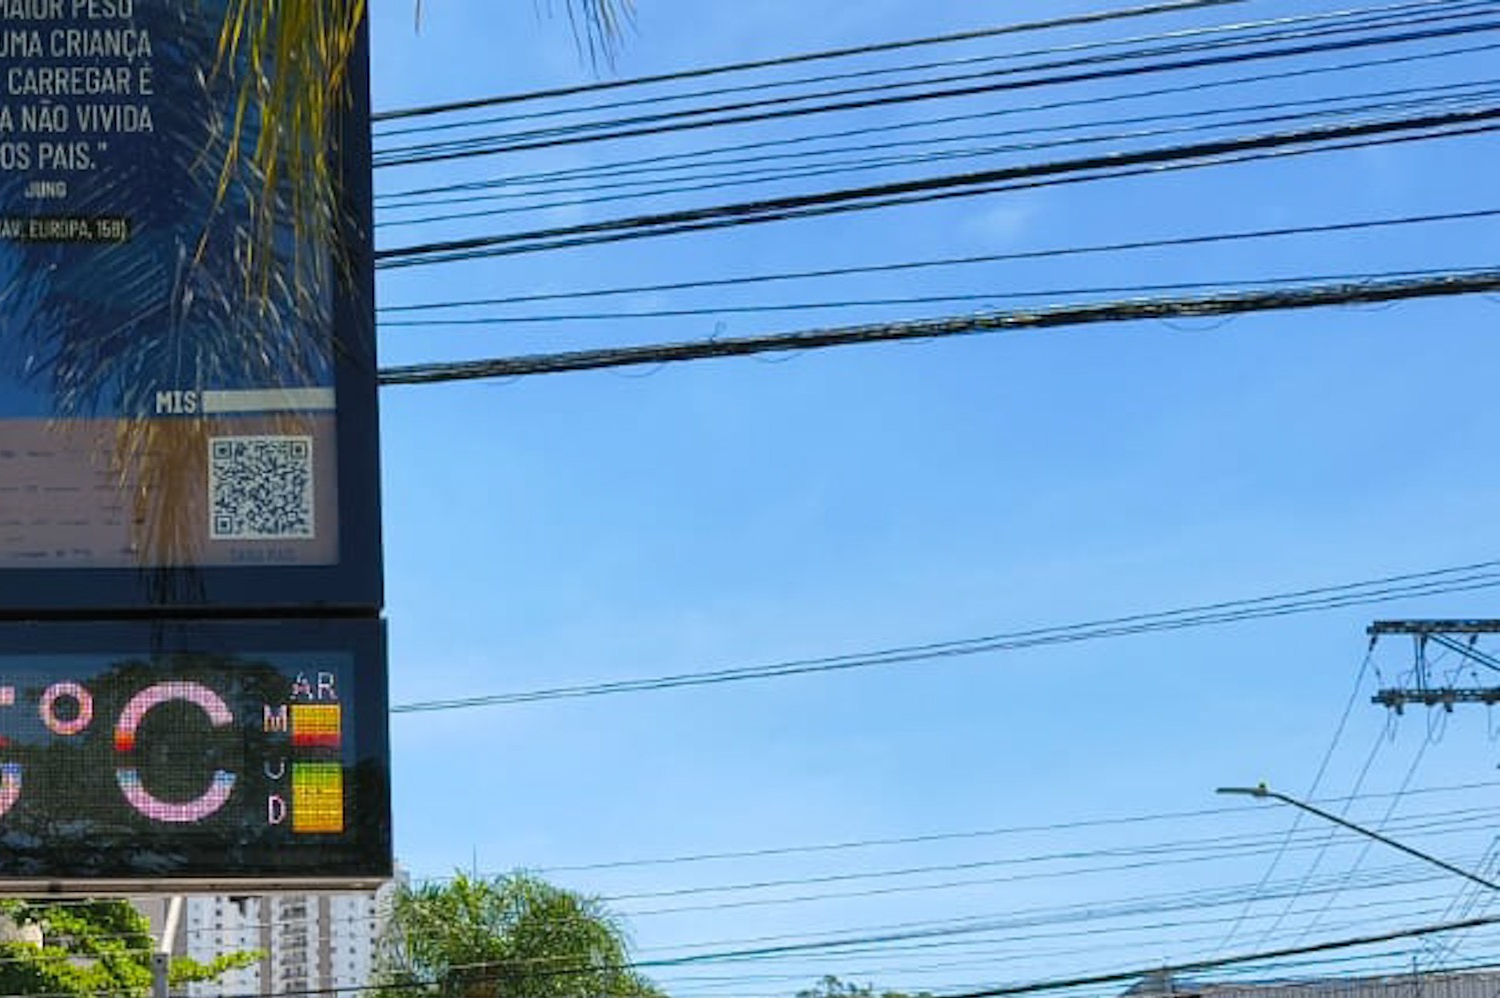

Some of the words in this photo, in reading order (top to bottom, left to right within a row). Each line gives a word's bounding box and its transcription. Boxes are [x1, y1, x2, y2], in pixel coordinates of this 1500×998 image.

[71, 0, 133, 20] PESO
[50, 29, 153, 64] CRIANÇA
[8, 67, 131, 96] CARREGAR
[21, 98, 70, 133] NÃO
[76, 104, 154, 133] VIVIDA
[156, 389, 198, 415] MIS
[290, 671, 338, 700] AR
